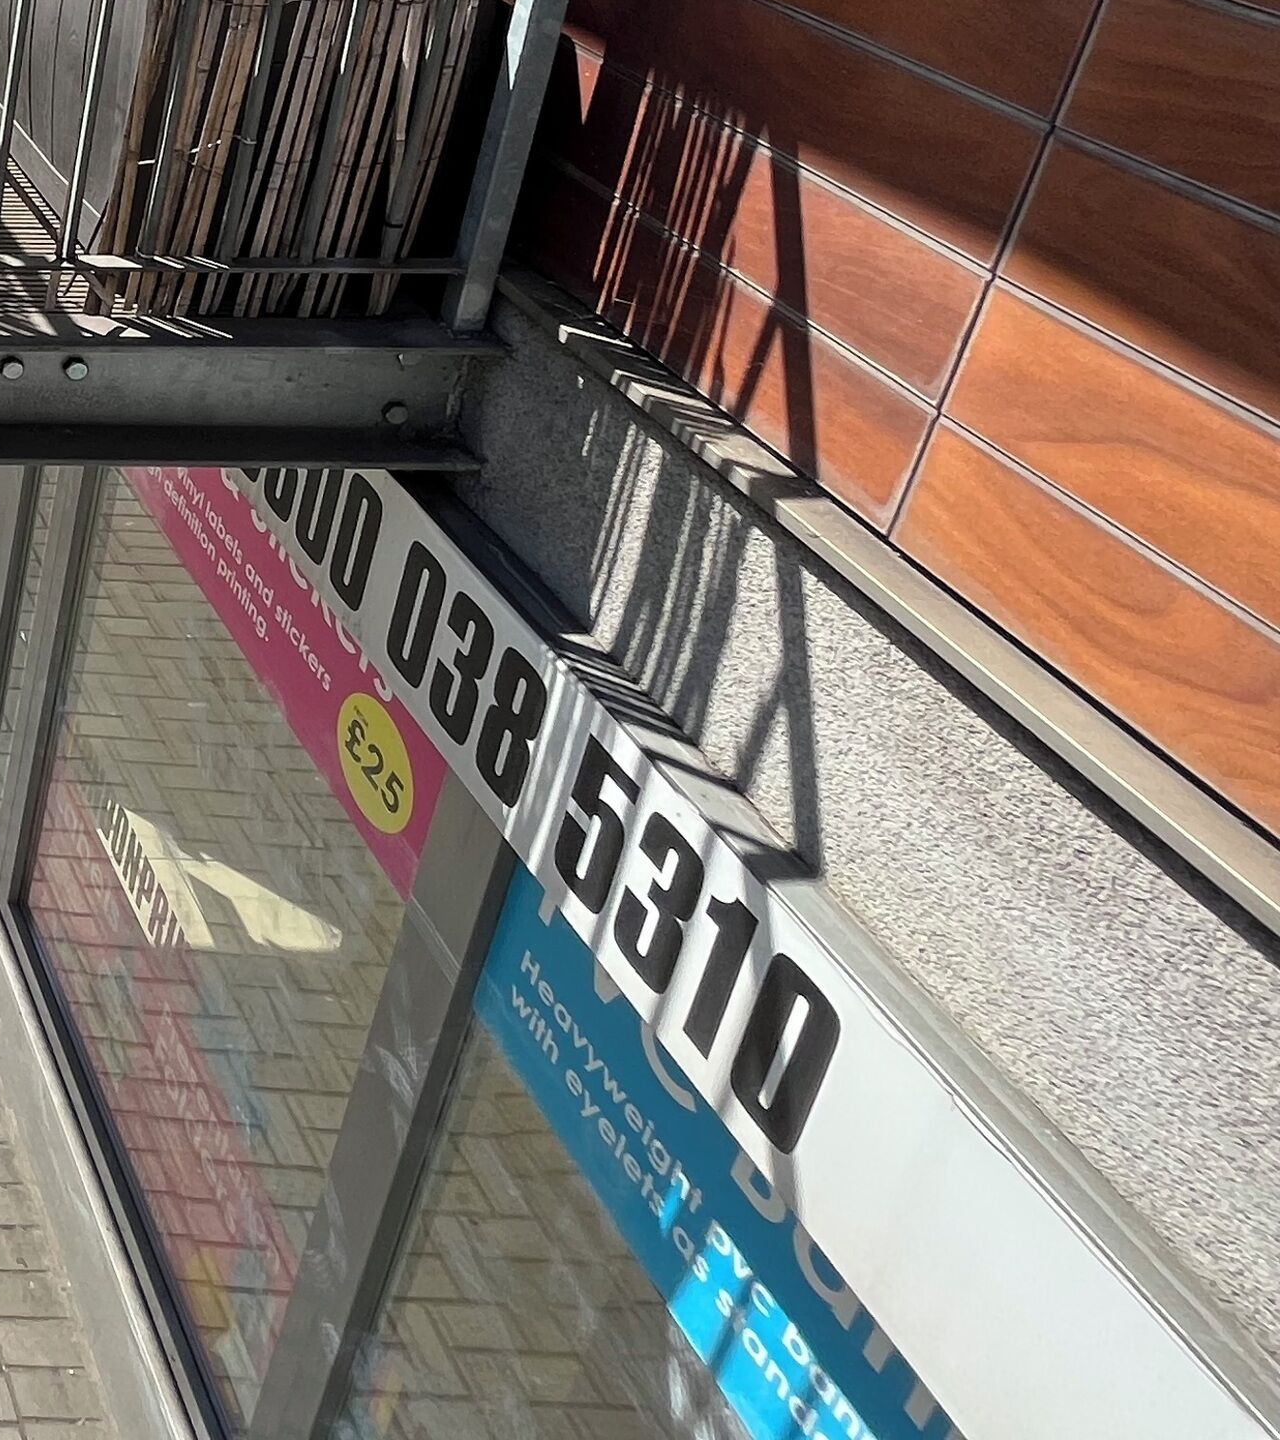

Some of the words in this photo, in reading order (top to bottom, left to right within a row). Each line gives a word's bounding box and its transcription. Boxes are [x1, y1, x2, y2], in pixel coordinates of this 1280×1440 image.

[163, 479, 217, 562] definition
[216, 557, 270, 643] printing.
[205, 501, 244, 565] labels
[245, 563, 275, 608] and
[274, 604, 333, 692] stickers
[345, 718, 405, 814] £25
[386, 540, 547, 809] 038
[554, 734, 841, 1155] 5310
[511, 984, 560, 1065] with
[564, 1068, 666, 1218] eyelets
[672, 1225, 710, 1283] as
[520, 949, 703, 1214] Heavyweight
